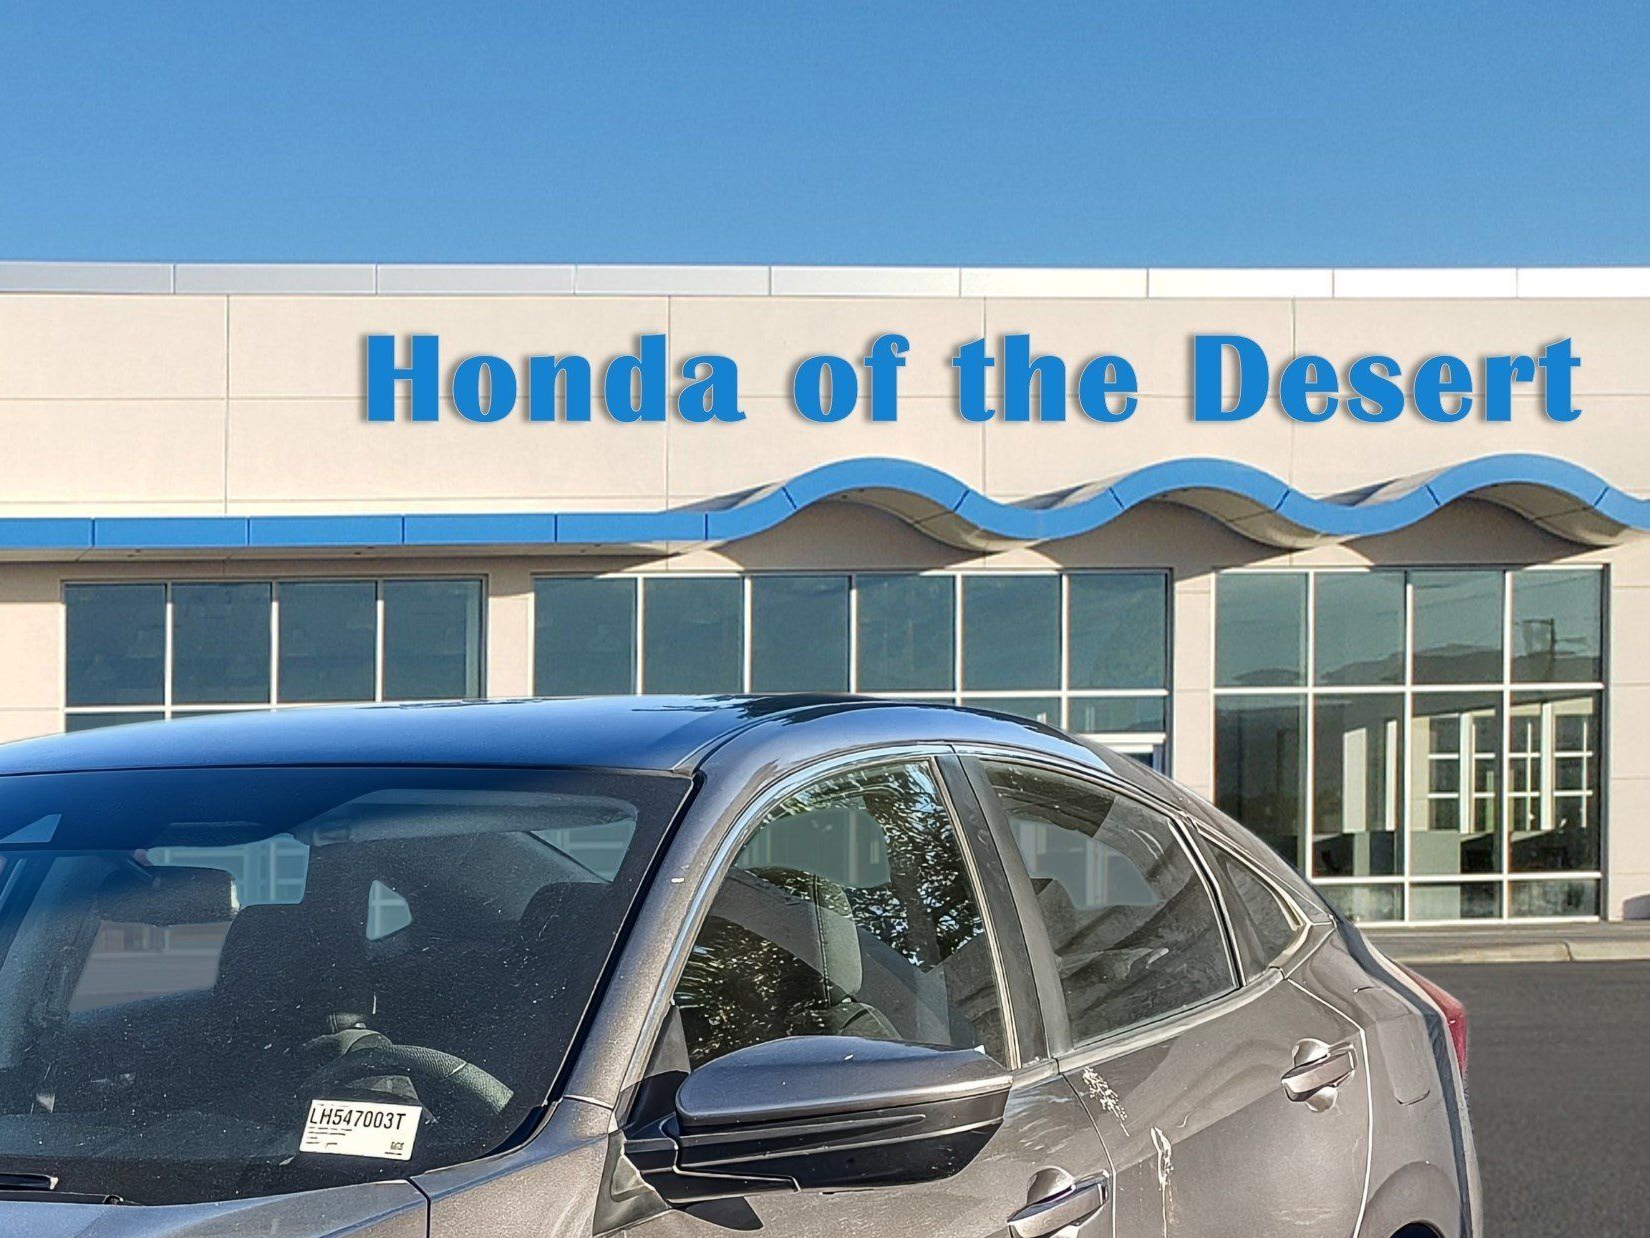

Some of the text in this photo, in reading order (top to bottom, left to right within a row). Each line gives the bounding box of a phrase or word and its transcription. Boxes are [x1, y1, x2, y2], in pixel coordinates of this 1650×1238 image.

[366, 333, 1583, 423] Honda of the Desert
[309, 1107, 407, 1131] LH547003T
